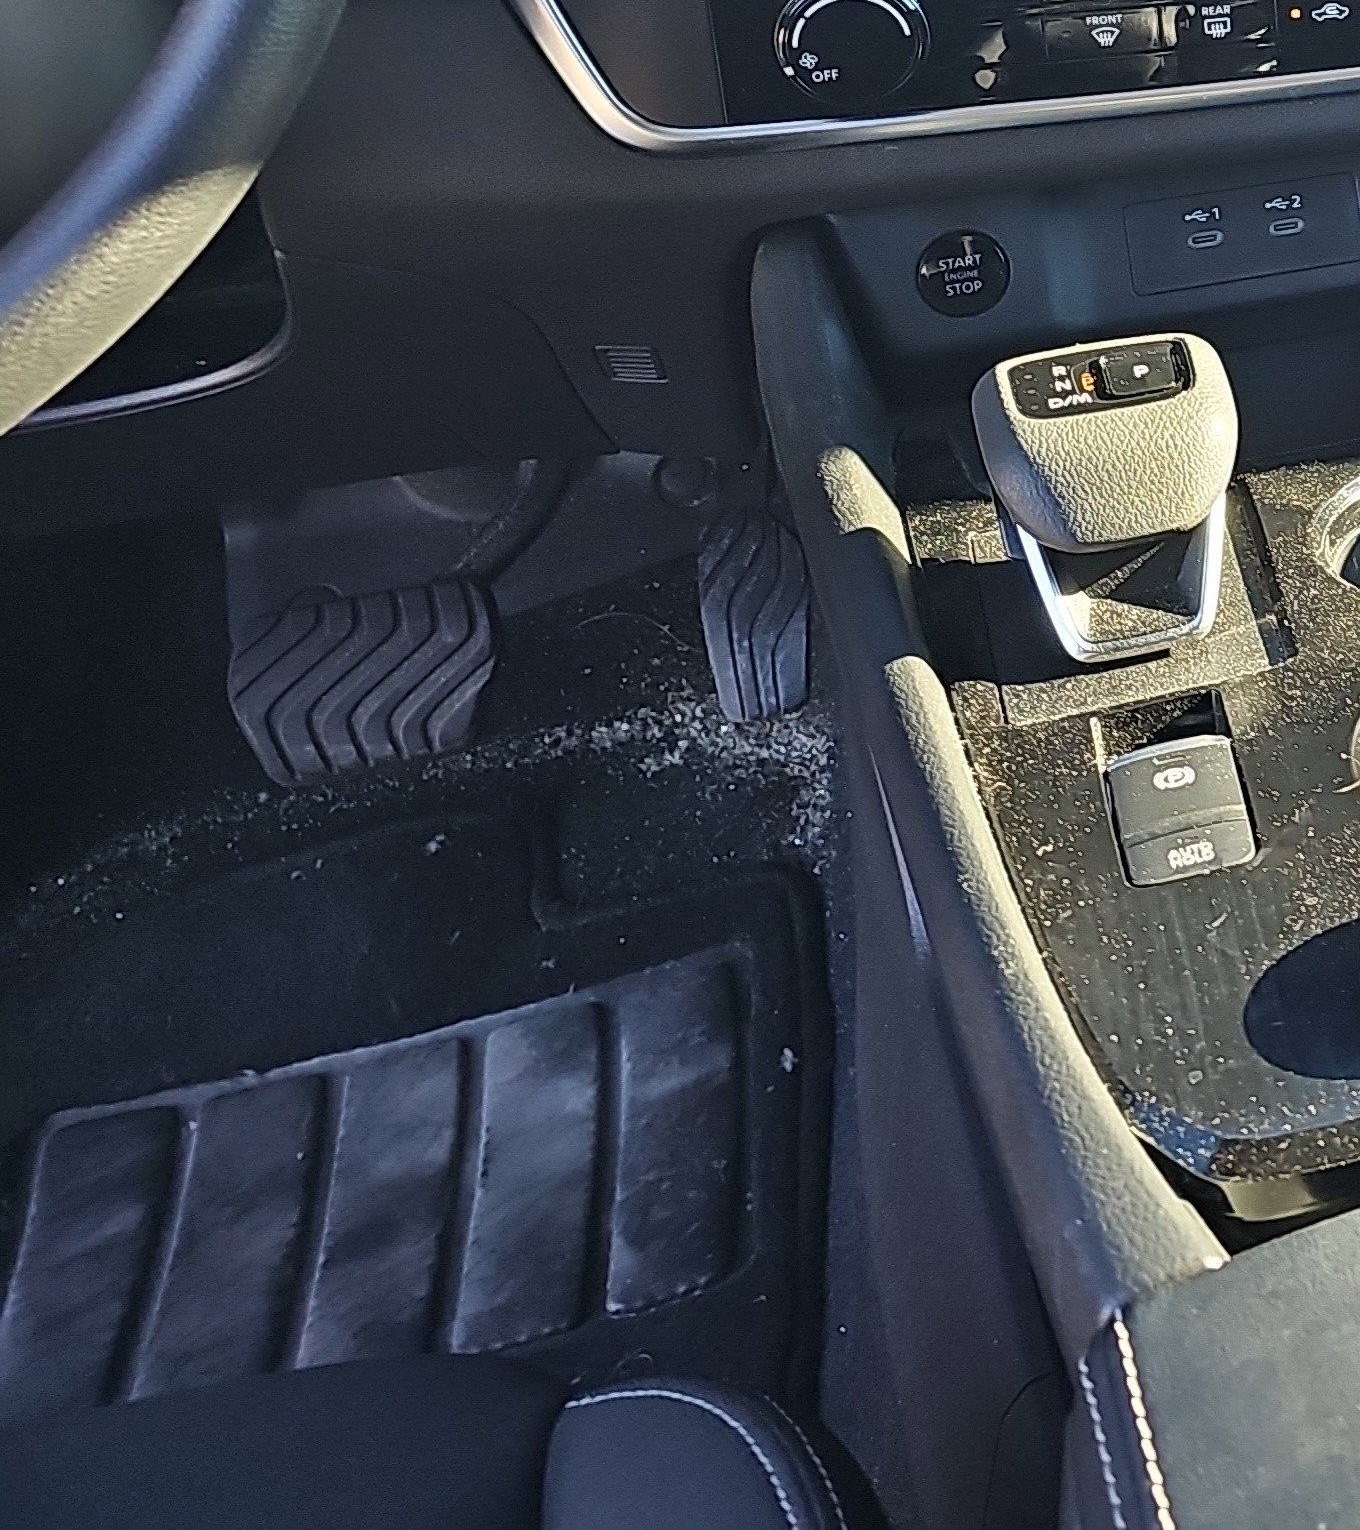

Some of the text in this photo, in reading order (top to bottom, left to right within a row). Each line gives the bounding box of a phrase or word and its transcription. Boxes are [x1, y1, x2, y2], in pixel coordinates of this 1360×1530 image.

[1201, 4, 1232, 17] REAR
[1085, 13, 1123, 26] FRONT
[811, 68, 840, 84] OFF
[1291, 195, 1302, 209] 2
[1212, 207, 1221, 221] 1
[938, 253, 983, 271] START
[945, 280, 983, 297] STOP
[1055, 378, 1073, 392] N
[1047, 392, 1094, 410] D/M
